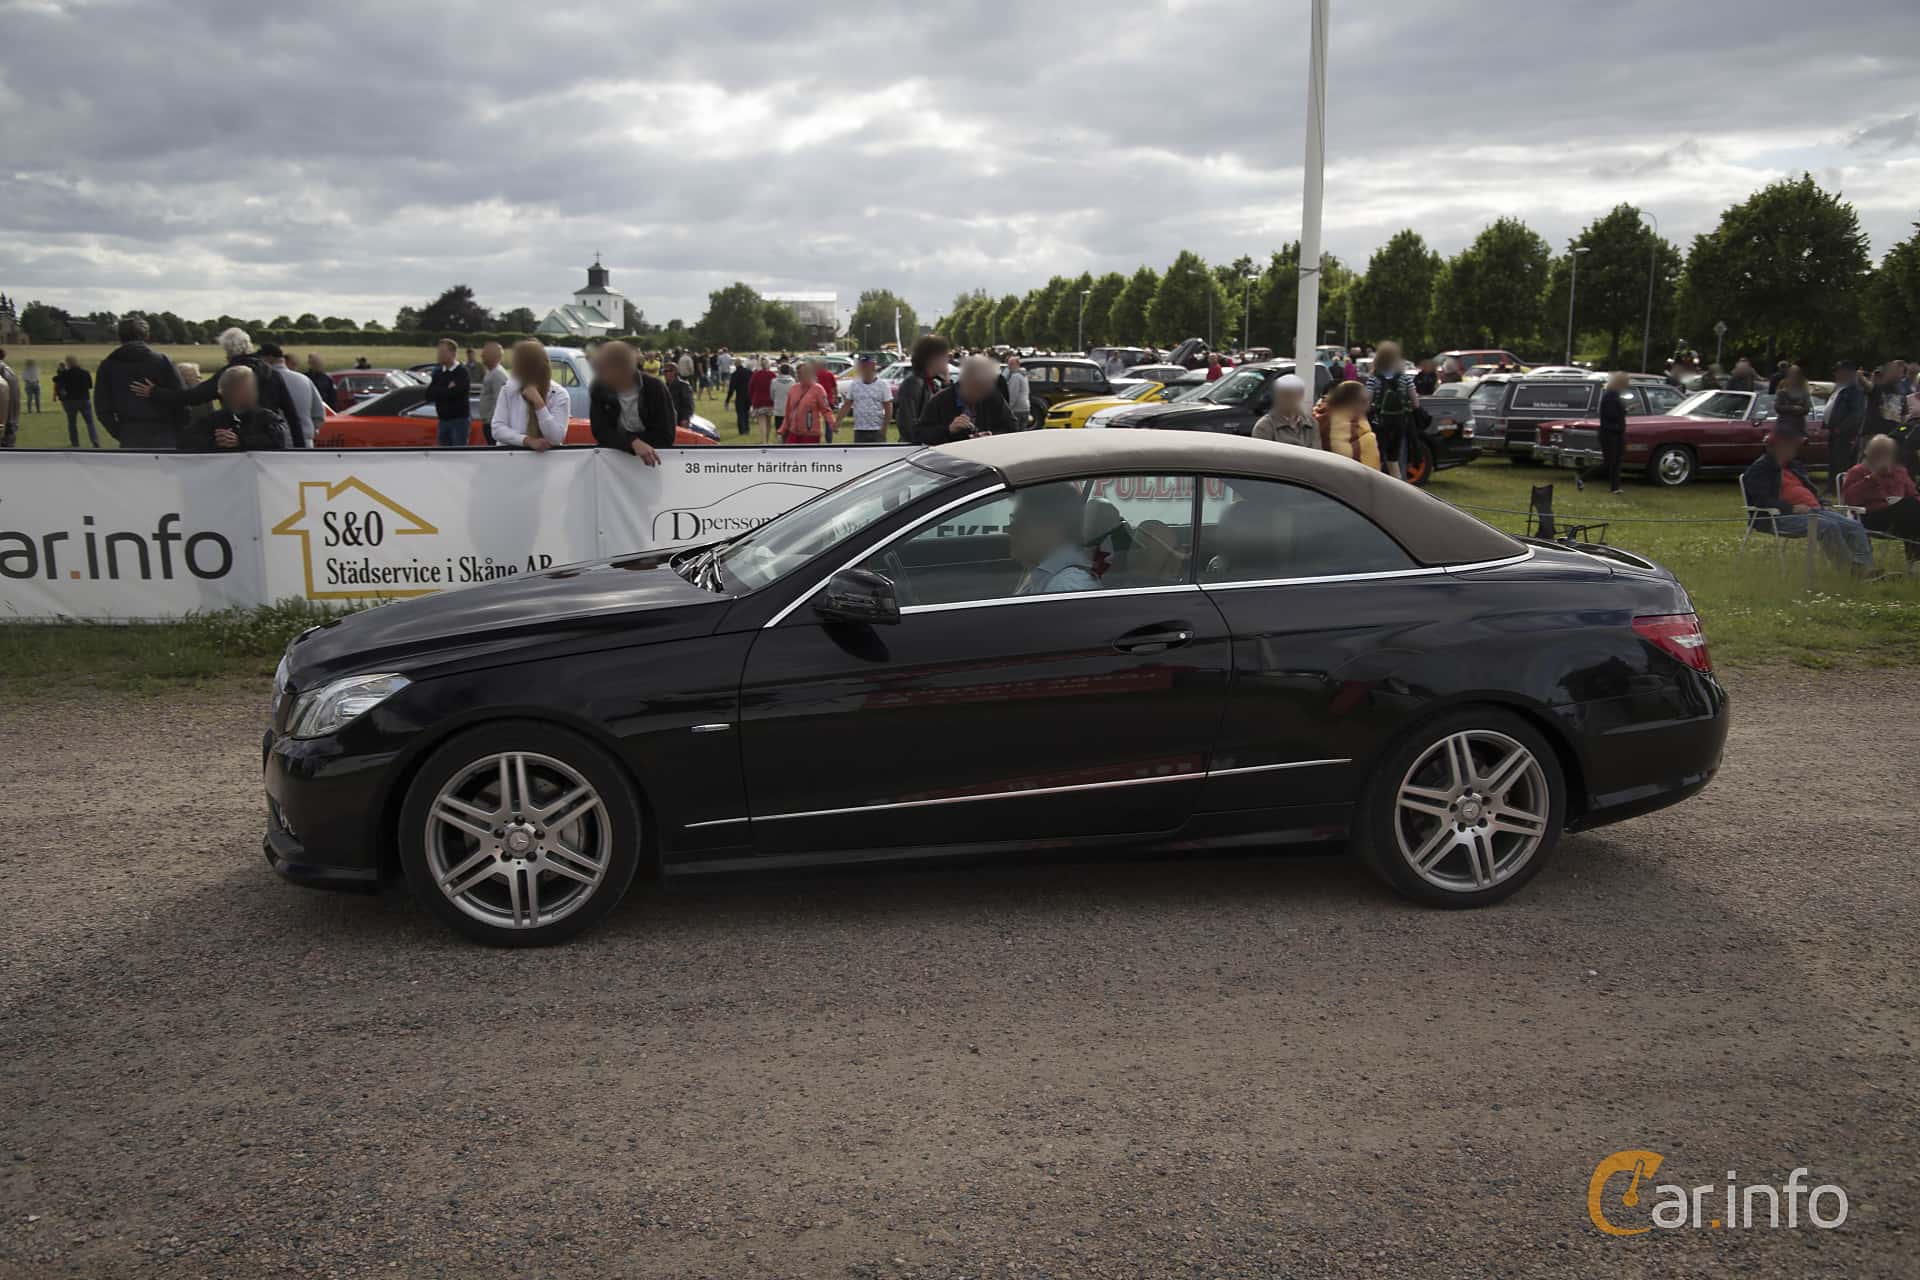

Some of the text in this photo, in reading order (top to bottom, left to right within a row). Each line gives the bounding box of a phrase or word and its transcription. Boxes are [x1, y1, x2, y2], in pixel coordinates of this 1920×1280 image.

[684, 460, 843, 474] 38 minuter härifrån finns
[322, 510, 383, 546] S&O
[326, 557, 441, 585] Städservice
[446, 557, 455, 583] i
[459, 556, 519, 583] Skåne
